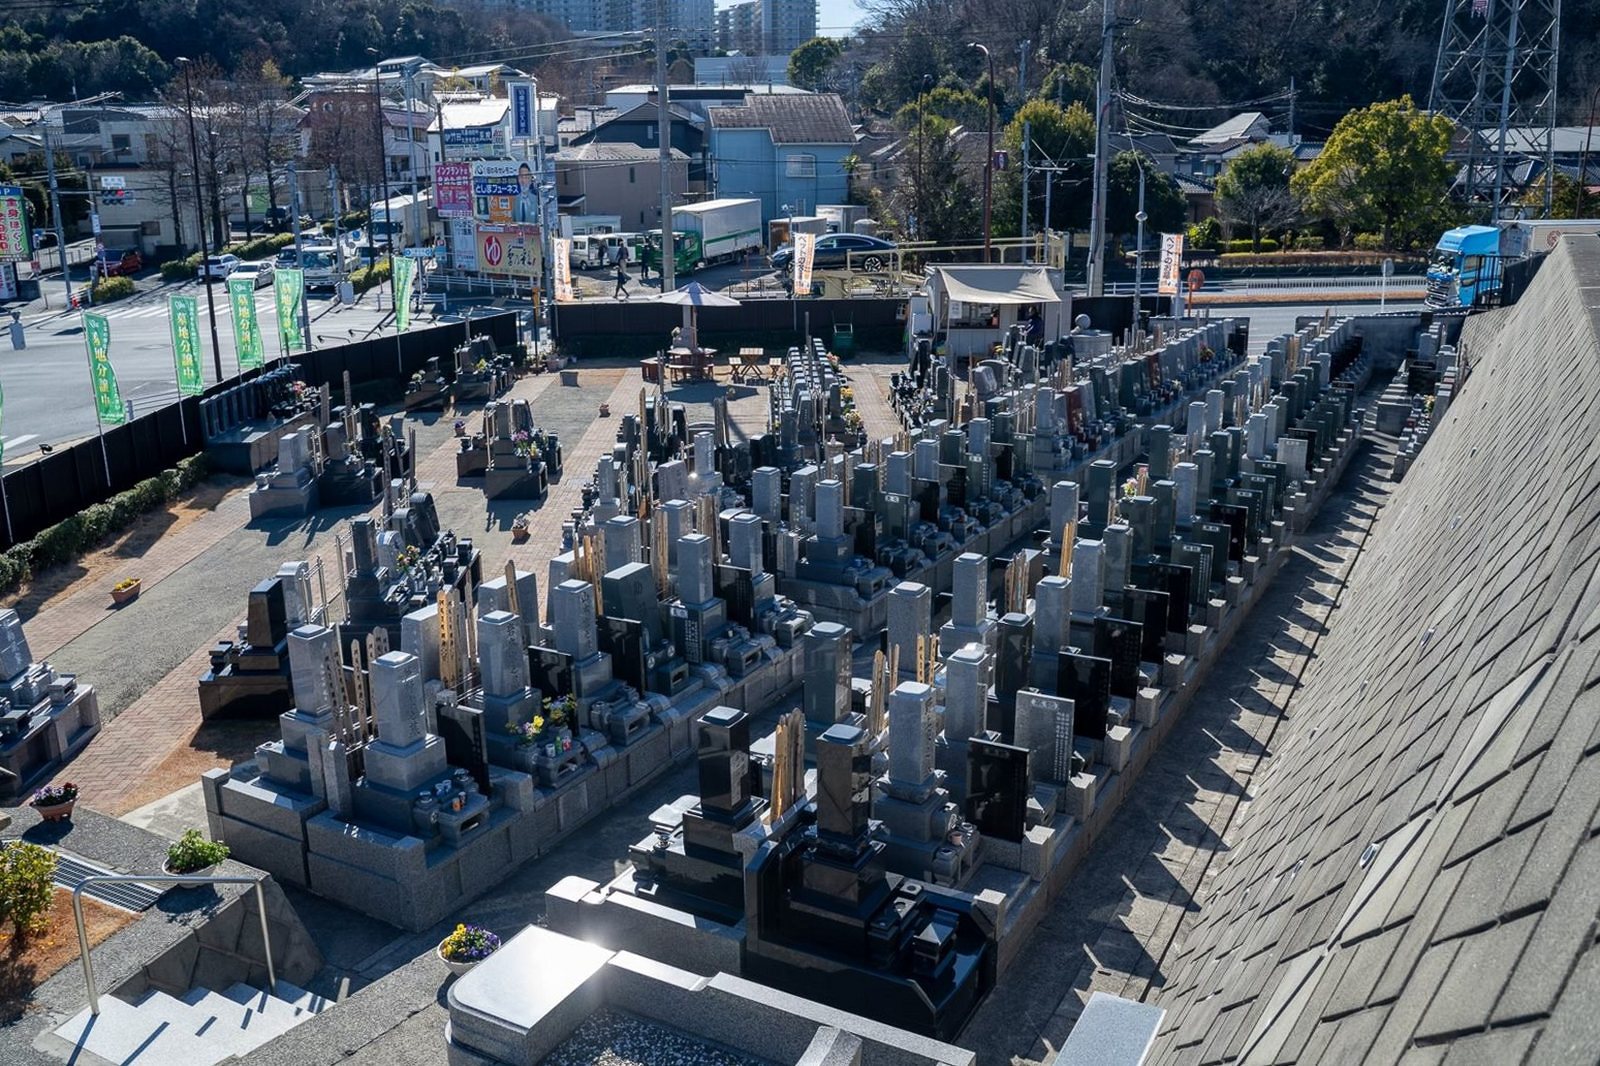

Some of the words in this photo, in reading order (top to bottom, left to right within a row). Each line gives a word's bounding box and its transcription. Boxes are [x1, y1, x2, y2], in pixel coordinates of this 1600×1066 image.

[176, 311, 194, 380] 墓地分譲中
